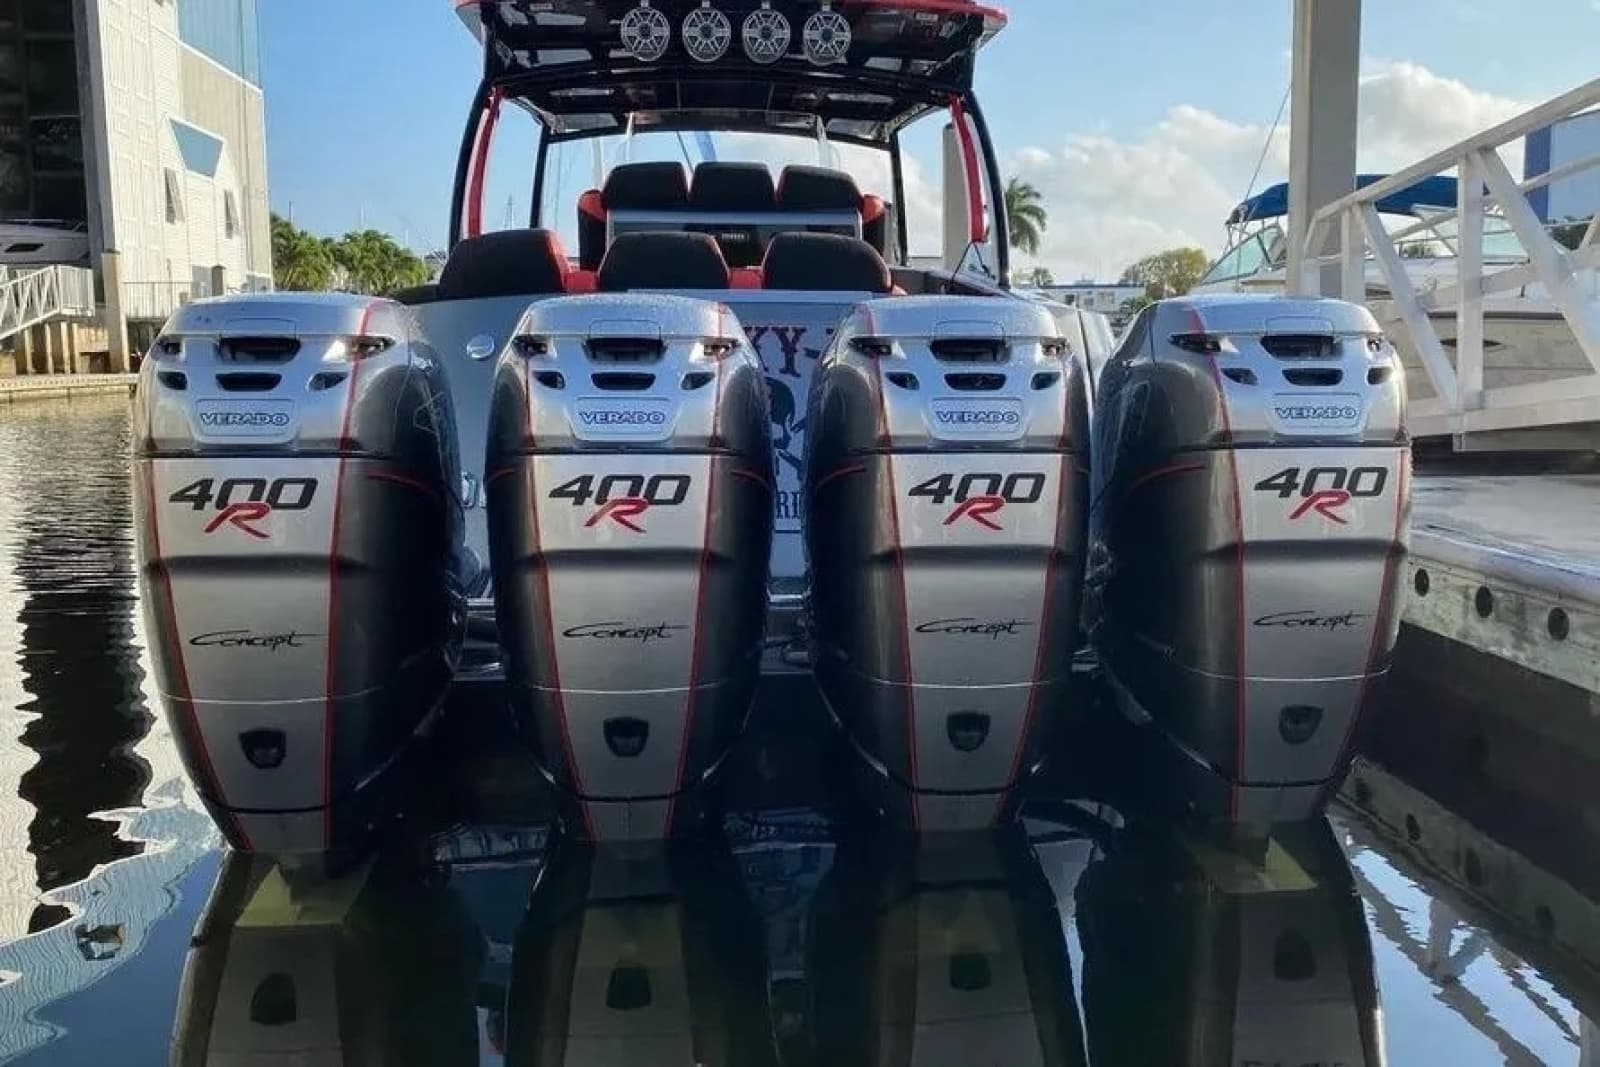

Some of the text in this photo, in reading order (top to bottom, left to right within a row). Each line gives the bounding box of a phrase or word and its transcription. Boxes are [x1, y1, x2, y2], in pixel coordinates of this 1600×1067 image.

[201, 412, 289, 427] VERADO
[579, 410, 665, 425] VERADO
[935, 410, 1019, 425] VERADO
[1274, 407, 1357, 420] VERADO
[168, 477, 319, 510] 400
[548, 474, 692, 506] 400
[908, 473, 1046, 503] 400
[1254, 466, 1389, 498] 400
[203, 502, 271, 539] R
[583, 498, 649, 534] R
[942, 496, 1005, 531] R
[1289, 490, 1351, 525] R
[562, 621, 691, 642] Concept
[915, 617, 1035, 640] Concept
[1253, 610, 1376, 632] Concept
[189, 630, 327, 653] Concept
